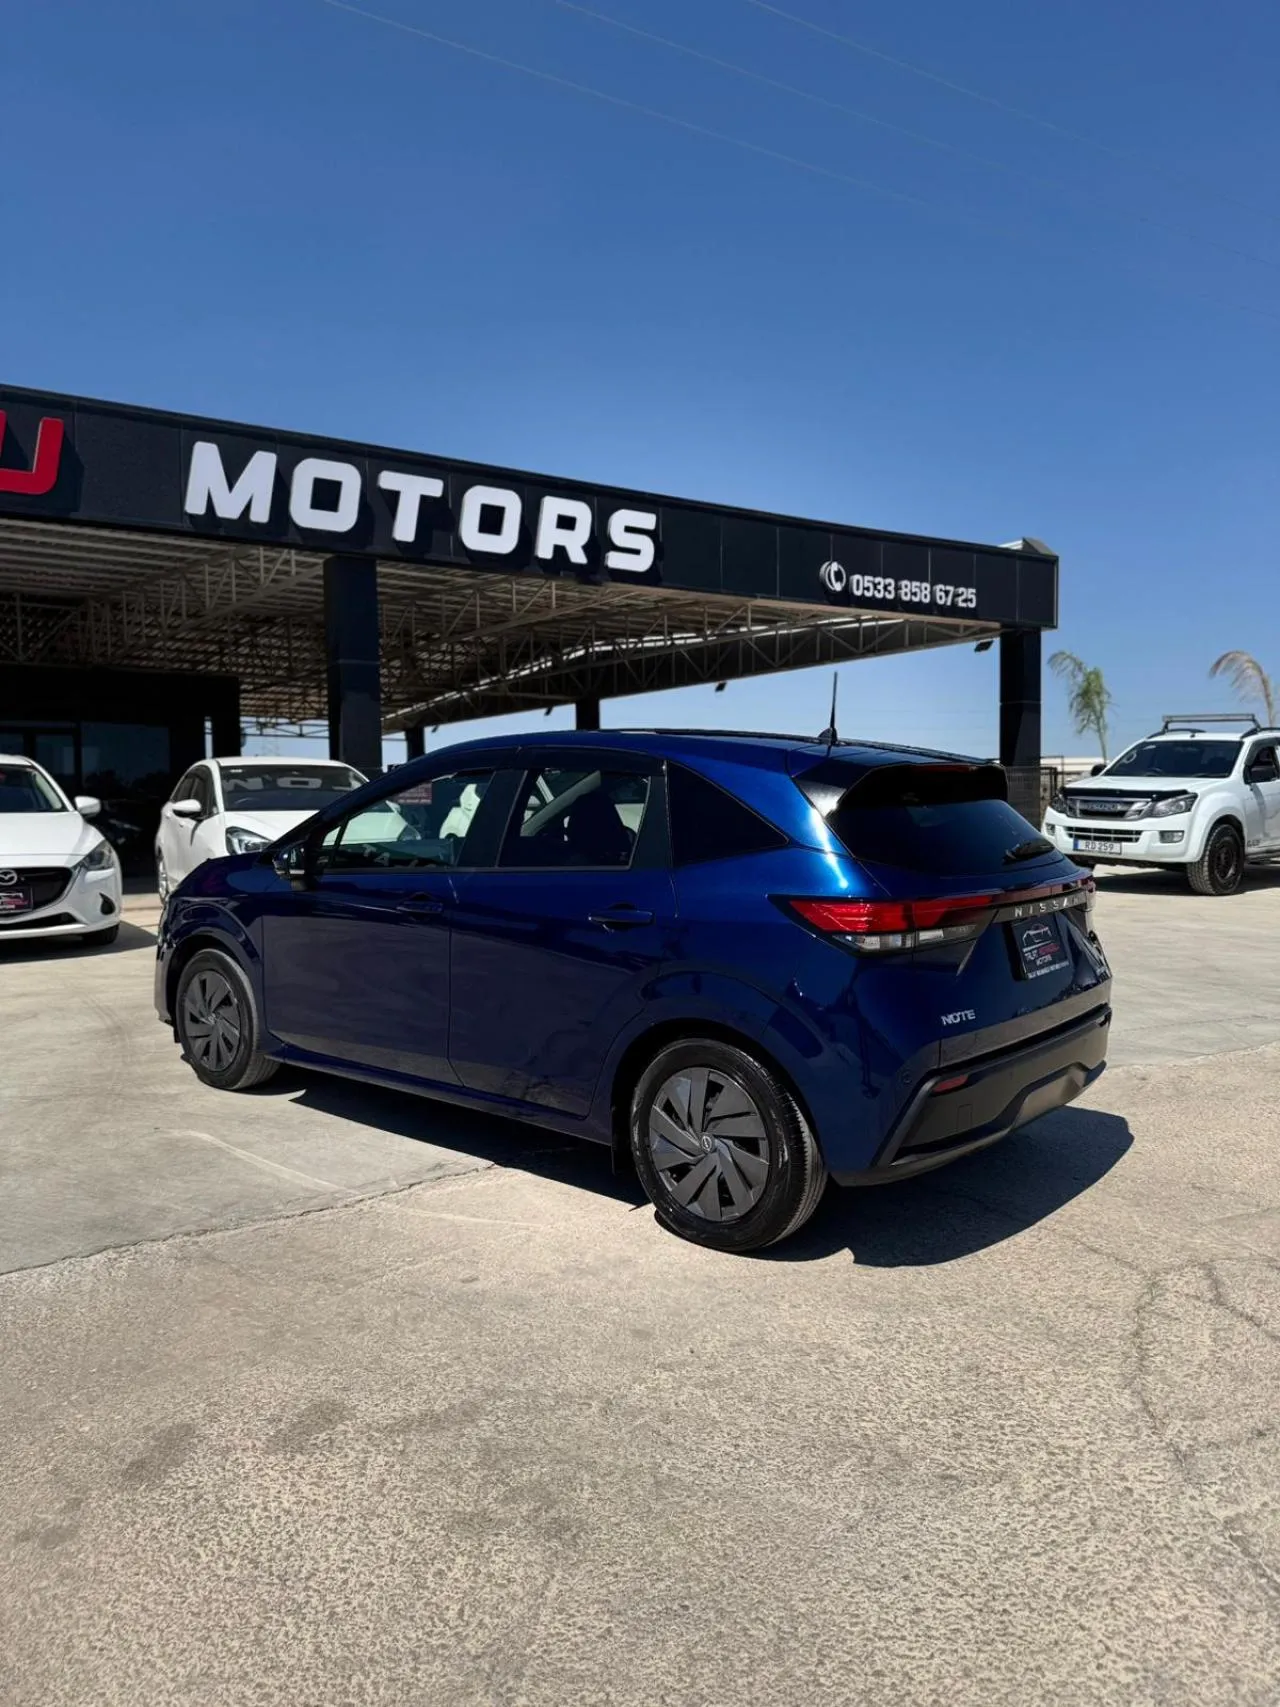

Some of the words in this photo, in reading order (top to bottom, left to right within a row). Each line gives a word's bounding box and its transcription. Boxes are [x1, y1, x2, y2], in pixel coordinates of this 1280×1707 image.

[184, 441, 657, 573] MOTORS
[851, 573, 895, 600] 0533
[899, 579, 931, 604] 858
[1085, 841, 1096, 850] RD
[1014, 896, 1080, 917] NISSAN
[940, 1008, 976, 1026] NOTE
